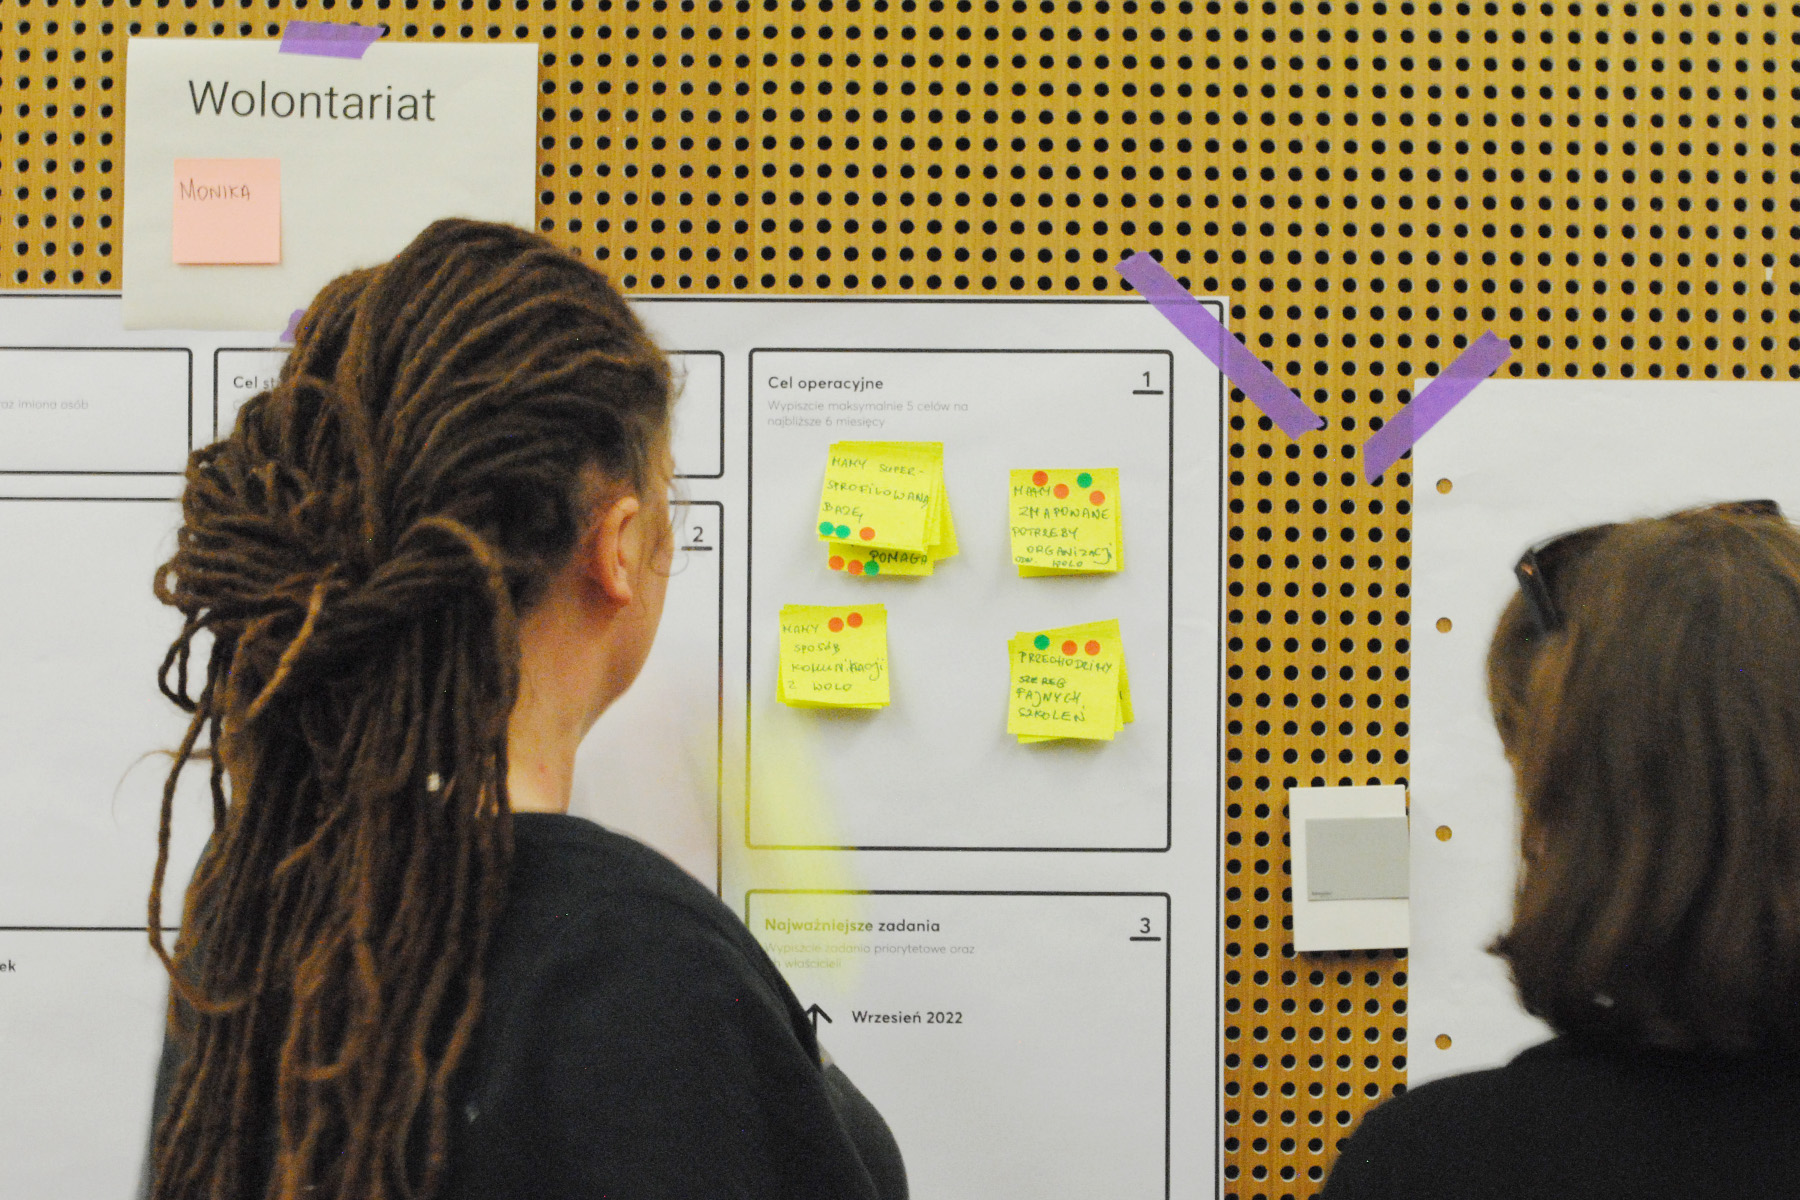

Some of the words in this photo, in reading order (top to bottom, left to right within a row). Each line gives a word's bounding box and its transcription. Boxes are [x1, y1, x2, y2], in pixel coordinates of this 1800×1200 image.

[189, 80, 436, 121] Wolontariat
[233, 375, 258, 389] Cel
[768, 376, 793, 389] Cel
[797, 376, 884, 392] operacyjne
[1142, 370, 1150, 388] 1
[18, 399, 57, 410] imiona
[767, 400, 825, 413] Wypiszcie
[828, 400, 904, 413] maksymalnie
[906, 401, 914, 412] 5
[917, 400, 950, 412] celów
[953, 403, 969, 412] na
[767, 416, 822, 428] najbliższe
[825, 417, 833, 427] 6
[836, 417, 885, 429] miesięcy
[692, 526, 704, 542] 2
[765, 918, 874, 935] Najważniejsze
[878, 918, 941, 932] zadania
[1139, 917, 1151, 934] 3
[874, 942, 947, 955] priorytetowe
[949, 945, 975, 954] oraz
[851, 1010, 922, 1024] Wrzesień
[926, 1011, 963, 1024] 2022
